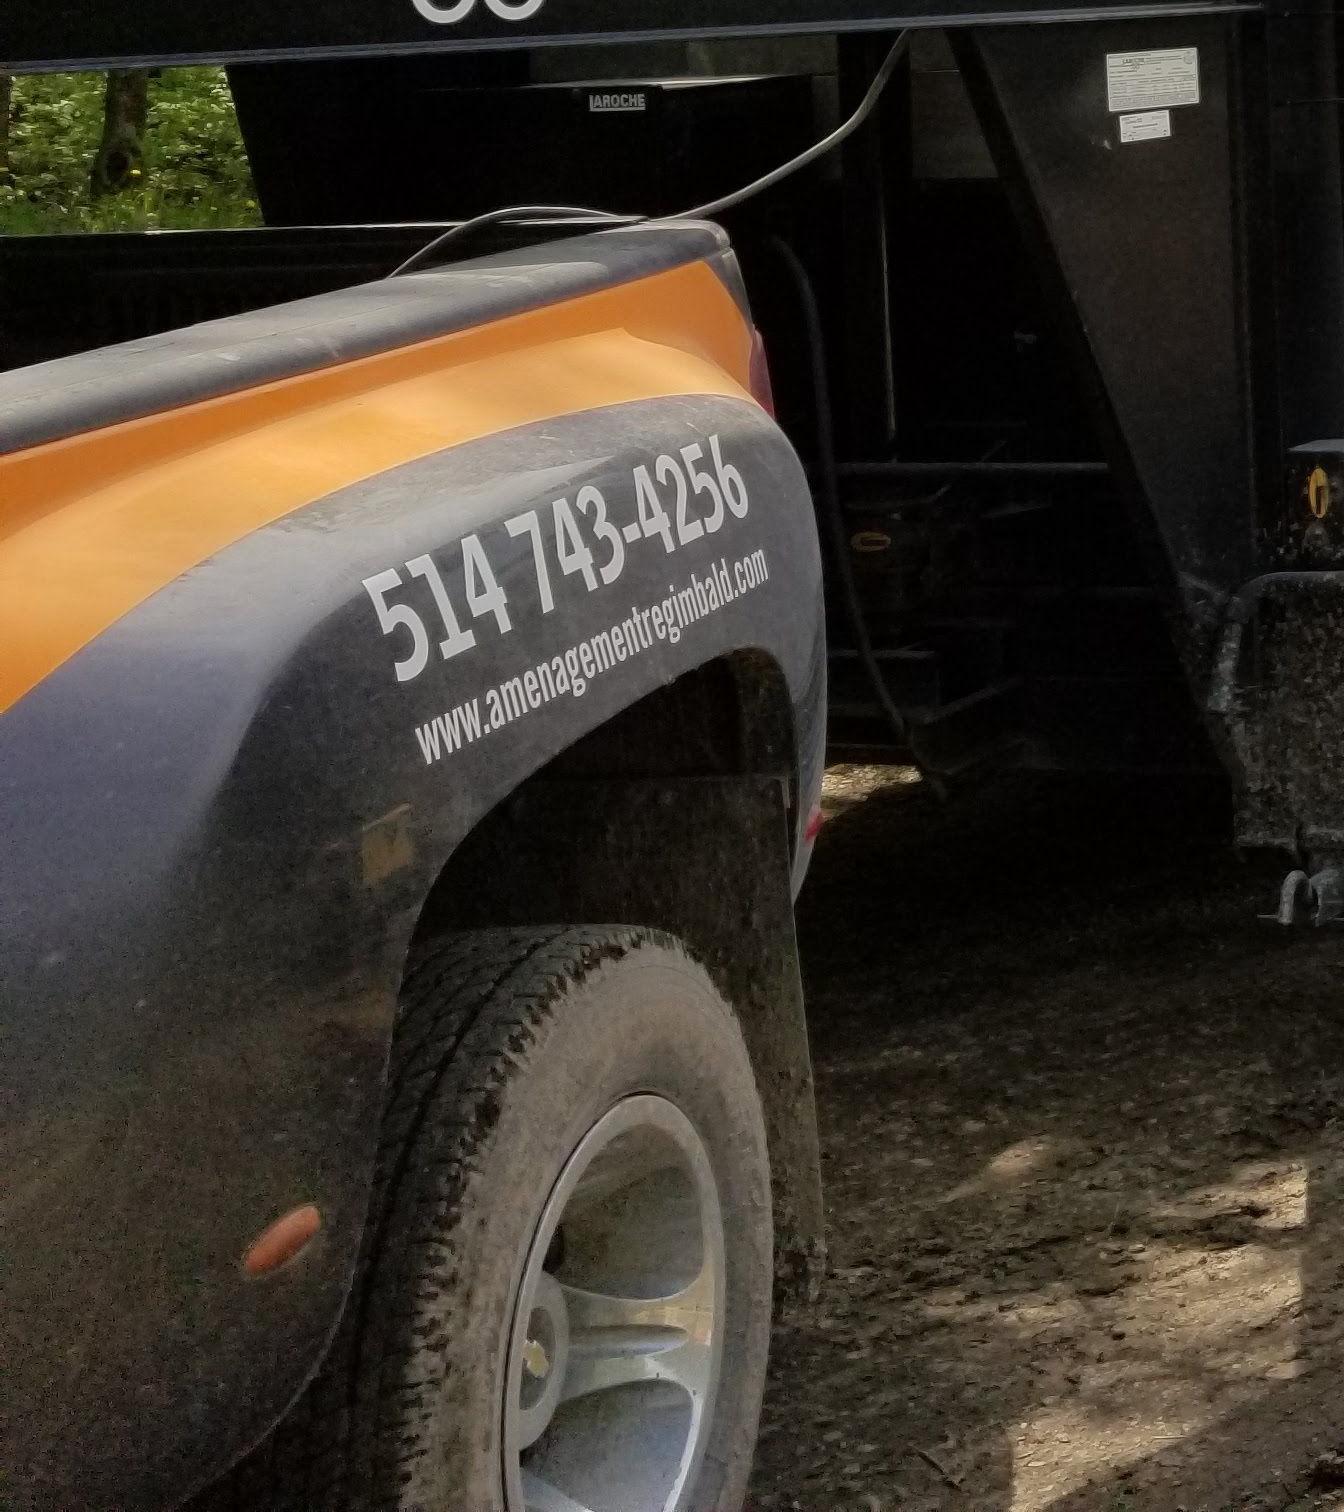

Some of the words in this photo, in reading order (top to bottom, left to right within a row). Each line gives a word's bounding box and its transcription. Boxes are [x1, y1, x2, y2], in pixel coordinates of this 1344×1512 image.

[588, 93, 646, 112] LAROCHE
[362, 534, 513, 682] 514
[504, 434, 750, 614] 743-4256
[414, 548, 770, 766] www.amenagementregimbald.com
